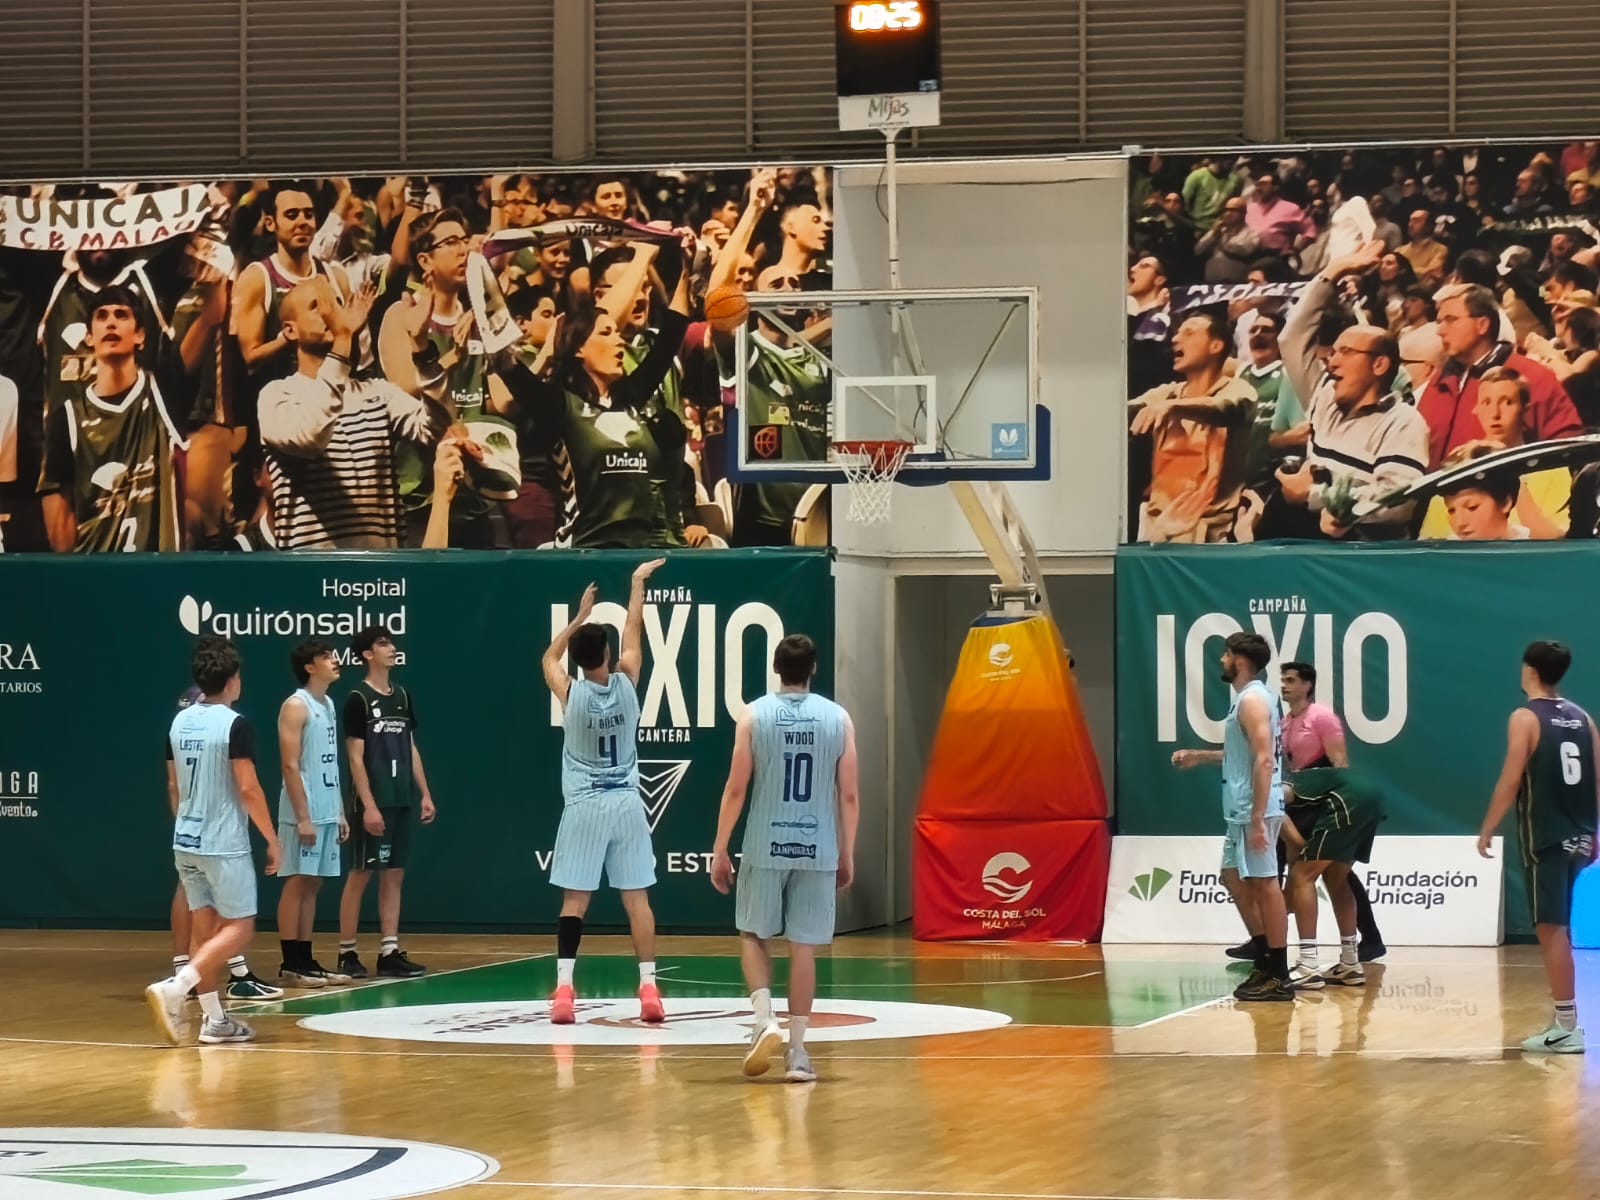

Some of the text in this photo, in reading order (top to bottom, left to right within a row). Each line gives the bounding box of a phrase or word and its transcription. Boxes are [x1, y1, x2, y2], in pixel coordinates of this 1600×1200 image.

[606, 452, 647, 471] Unicaja
[322, 577, 406, 601] Hospital
[642, 586, 692, 603] AMPAÑA
[1249, 595, 1307, 613] CAMPAÑA
[212, 605, 406, 640] quirónsalud
[638, 728, 691, 743] CANTERA
[784, 731, 815, 746] WOOD
[598, 734, 618, 767] 4
[1559, 741, 1582, 785] 6
[186, 757, 198, 800] 7
[782, 751, 813, 803] 10
[1366, 870, 1478, 888] Fundación
[1367, 889, 1445, 909] Unicaja
[963, 907, 1046, 919] COSTA DEL SOL
